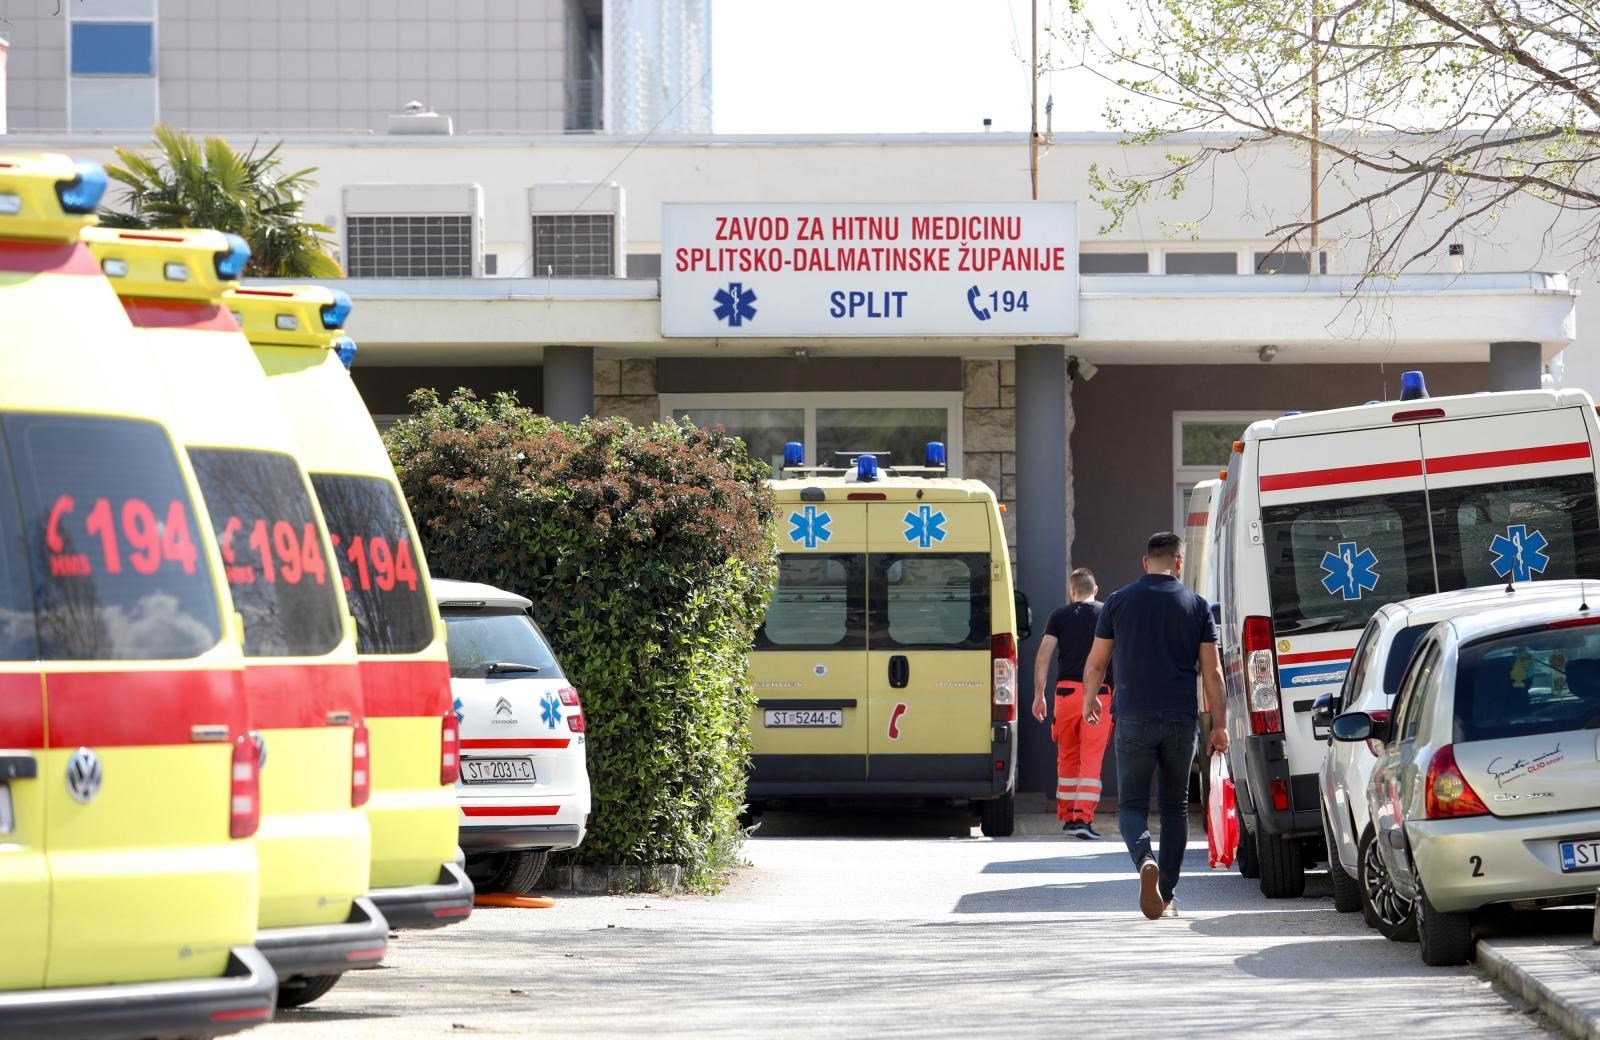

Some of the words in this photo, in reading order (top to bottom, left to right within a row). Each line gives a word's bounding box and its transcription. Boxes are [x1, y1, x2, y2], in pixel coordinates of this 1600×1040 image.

[715, 216, 789, 241] ZAVOD
[797, 217, 824, 241] ZA
[832, 216, 899, 241] HITNU
[911, 216, 1022, 241] MEDICINU
[675, 247, 950, 273] SPLITSKO-DALMATINSKE
[957, 243, 1065, 273] ŽUPANIJE
[830, 291, 908, 319] SPLIT
[989, 291, 1029, 313] 194
[86, 498, 197, 576] 194
[250, 518, 326, 585] 194
[347, 536, 417, 592] 194
[773, 711, 788, 725] ST
[795, 711, 837, 725] 5244-C
[468, 762, 483, 779] ST
[490, 762, 530, 778] 2031-C
[1576, 843, 1600, 864] ST
[1469, 855, 1485, 878] 2
